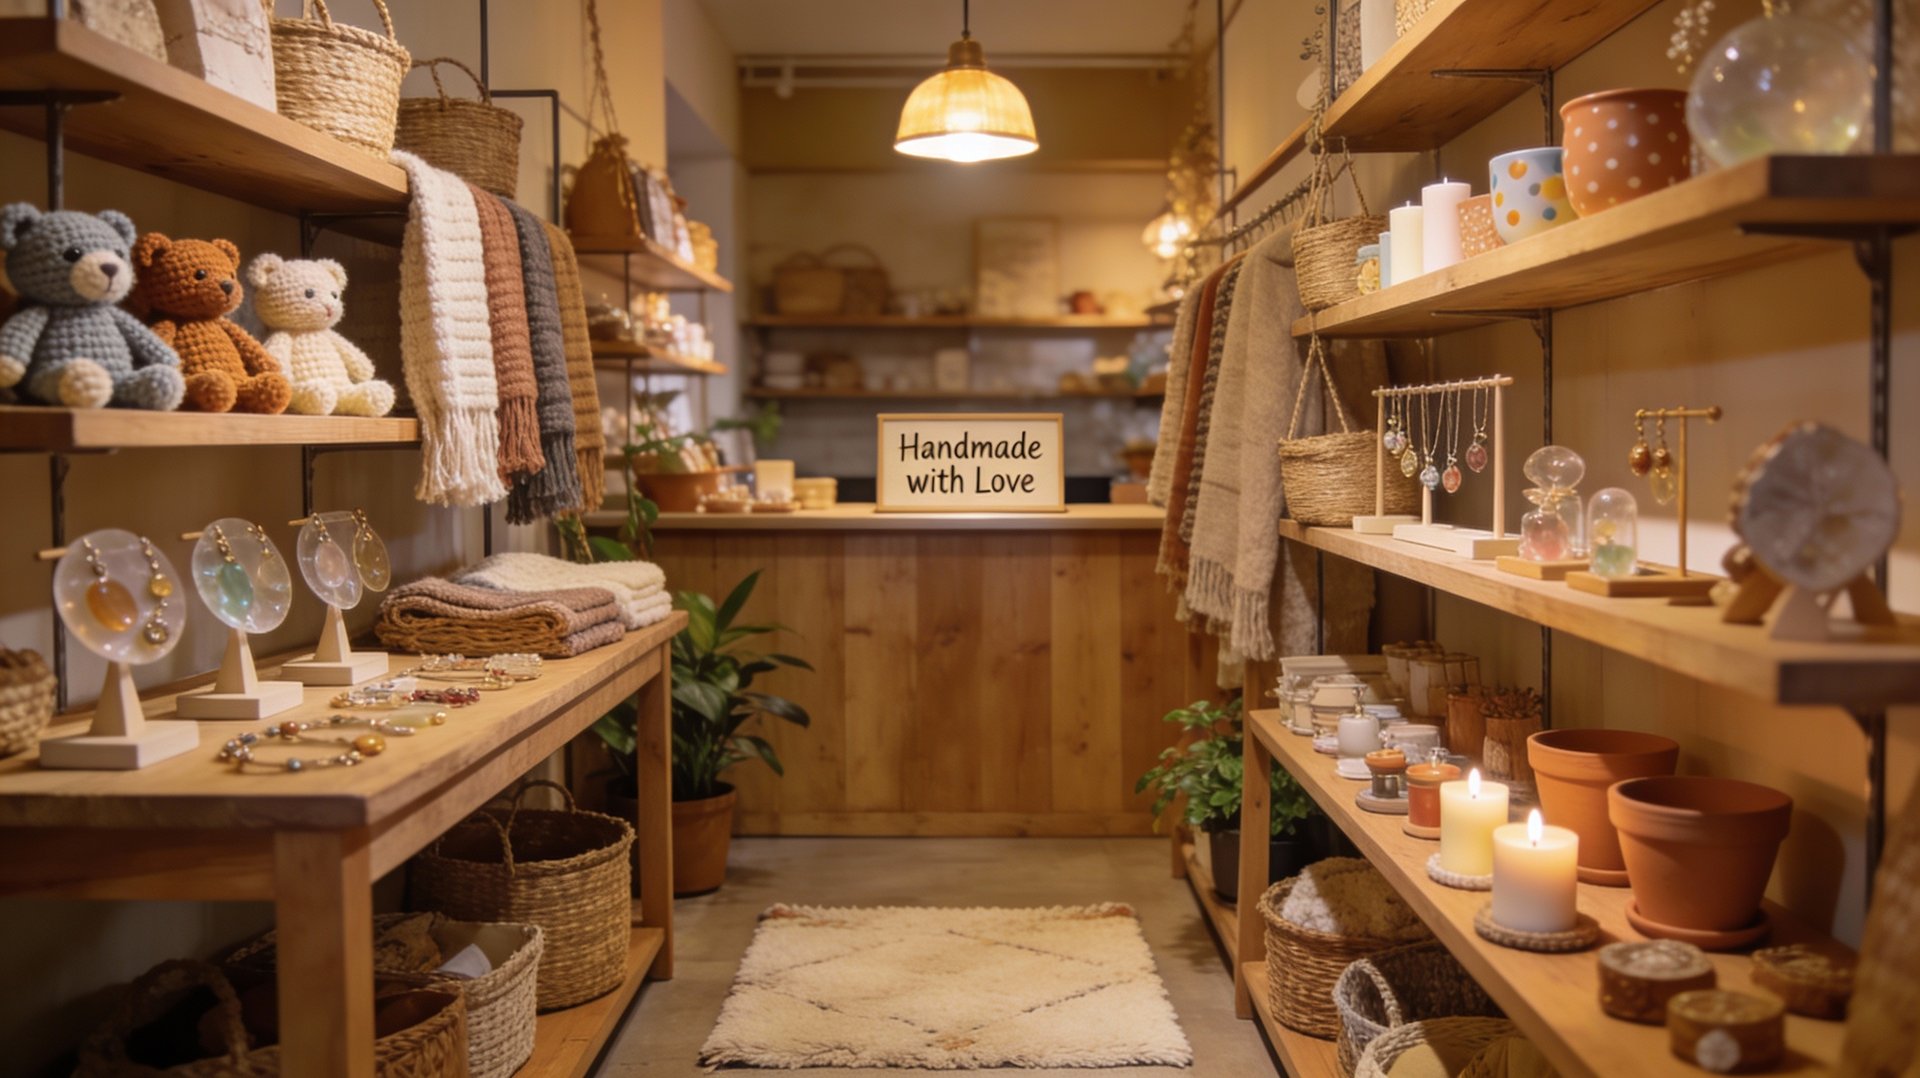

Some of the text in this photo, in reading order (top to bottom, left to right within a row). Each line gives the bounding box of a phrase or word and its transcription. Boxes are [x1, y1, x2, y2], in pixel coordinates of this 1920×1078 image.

[900, 431, 1042, 461] Handmade
[907, 465, 1035, 494] with Love
